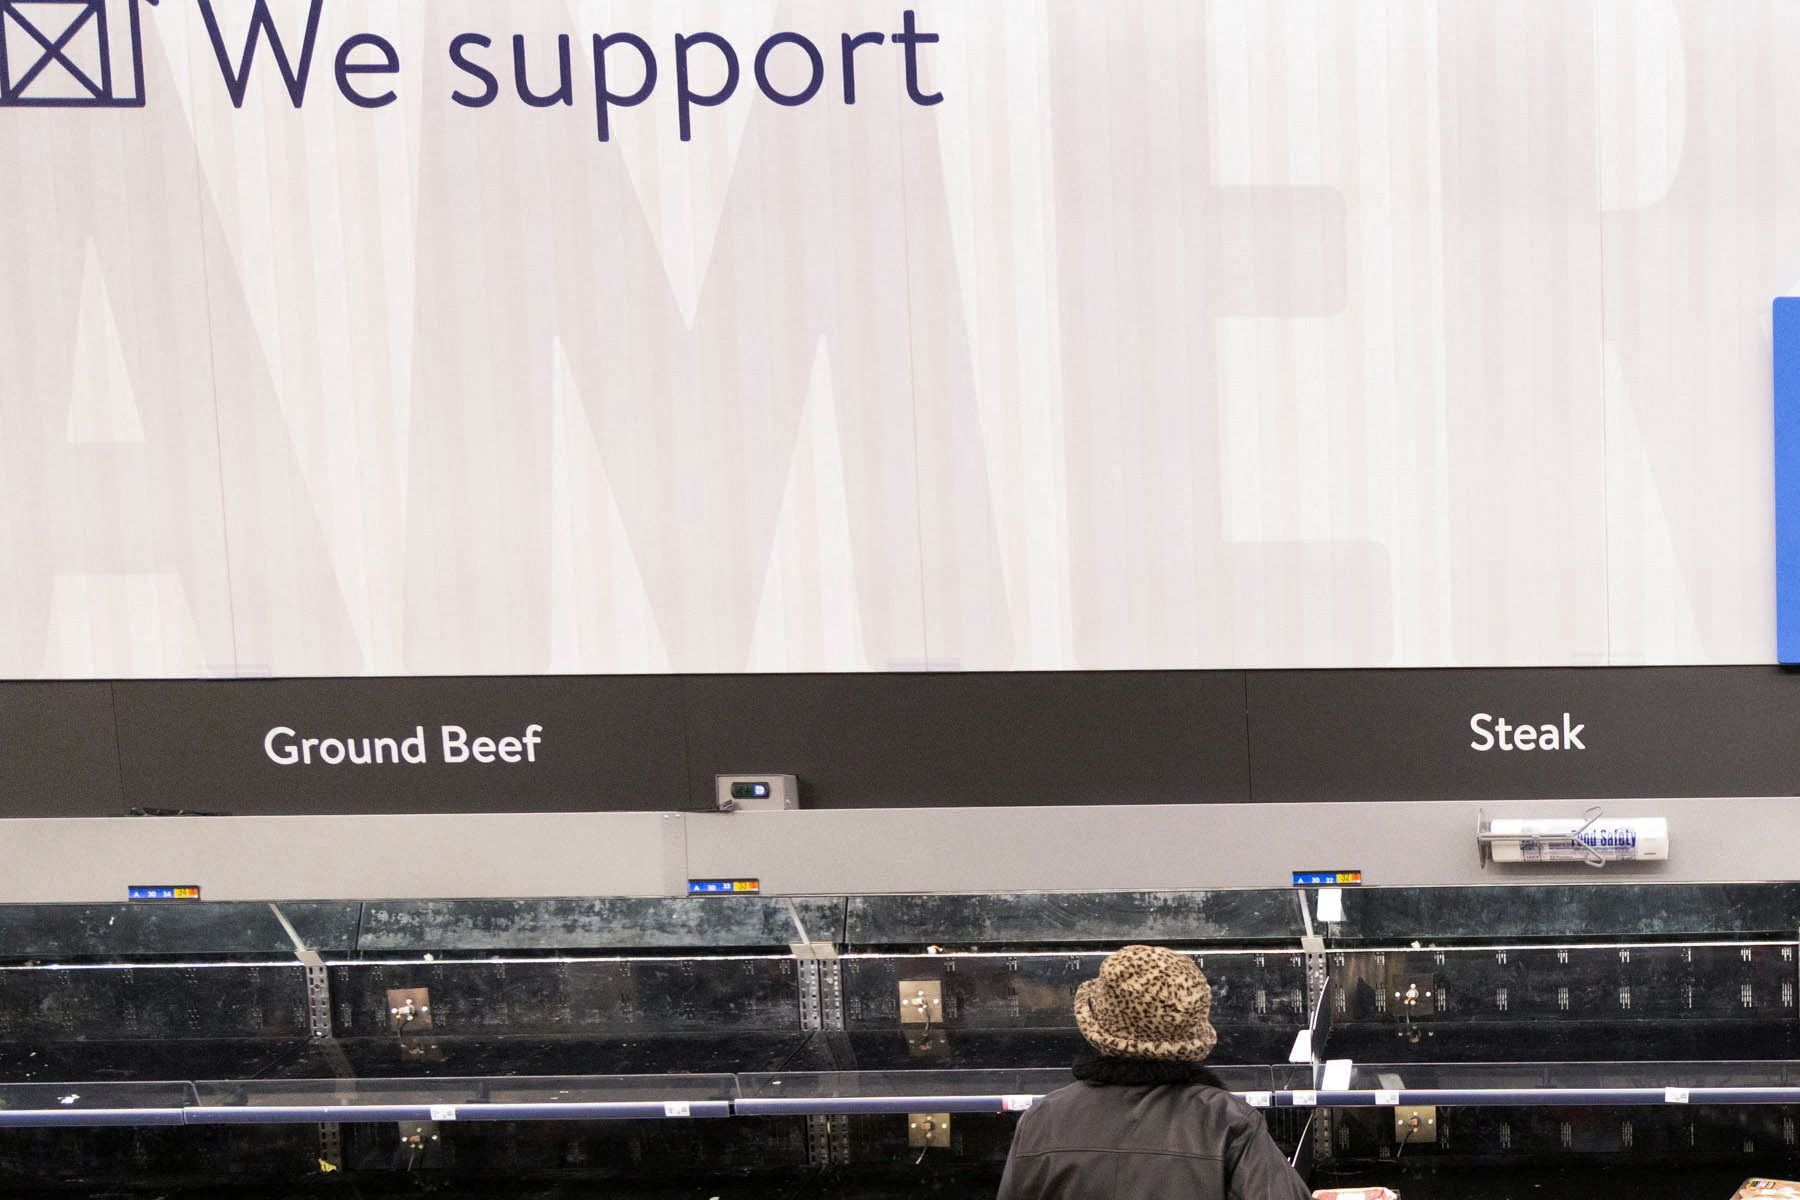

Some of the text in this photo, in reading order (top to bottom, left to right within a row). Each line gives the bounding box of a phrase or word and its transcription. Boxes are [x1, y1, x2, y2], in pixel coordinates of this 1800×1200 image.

[197, 0, 945, 143] We support
[264, 724, 544, 765] Ground Beef
[1470, 712, 1586, 752] Steak
[1600, 829, 1637, 848] Safety
